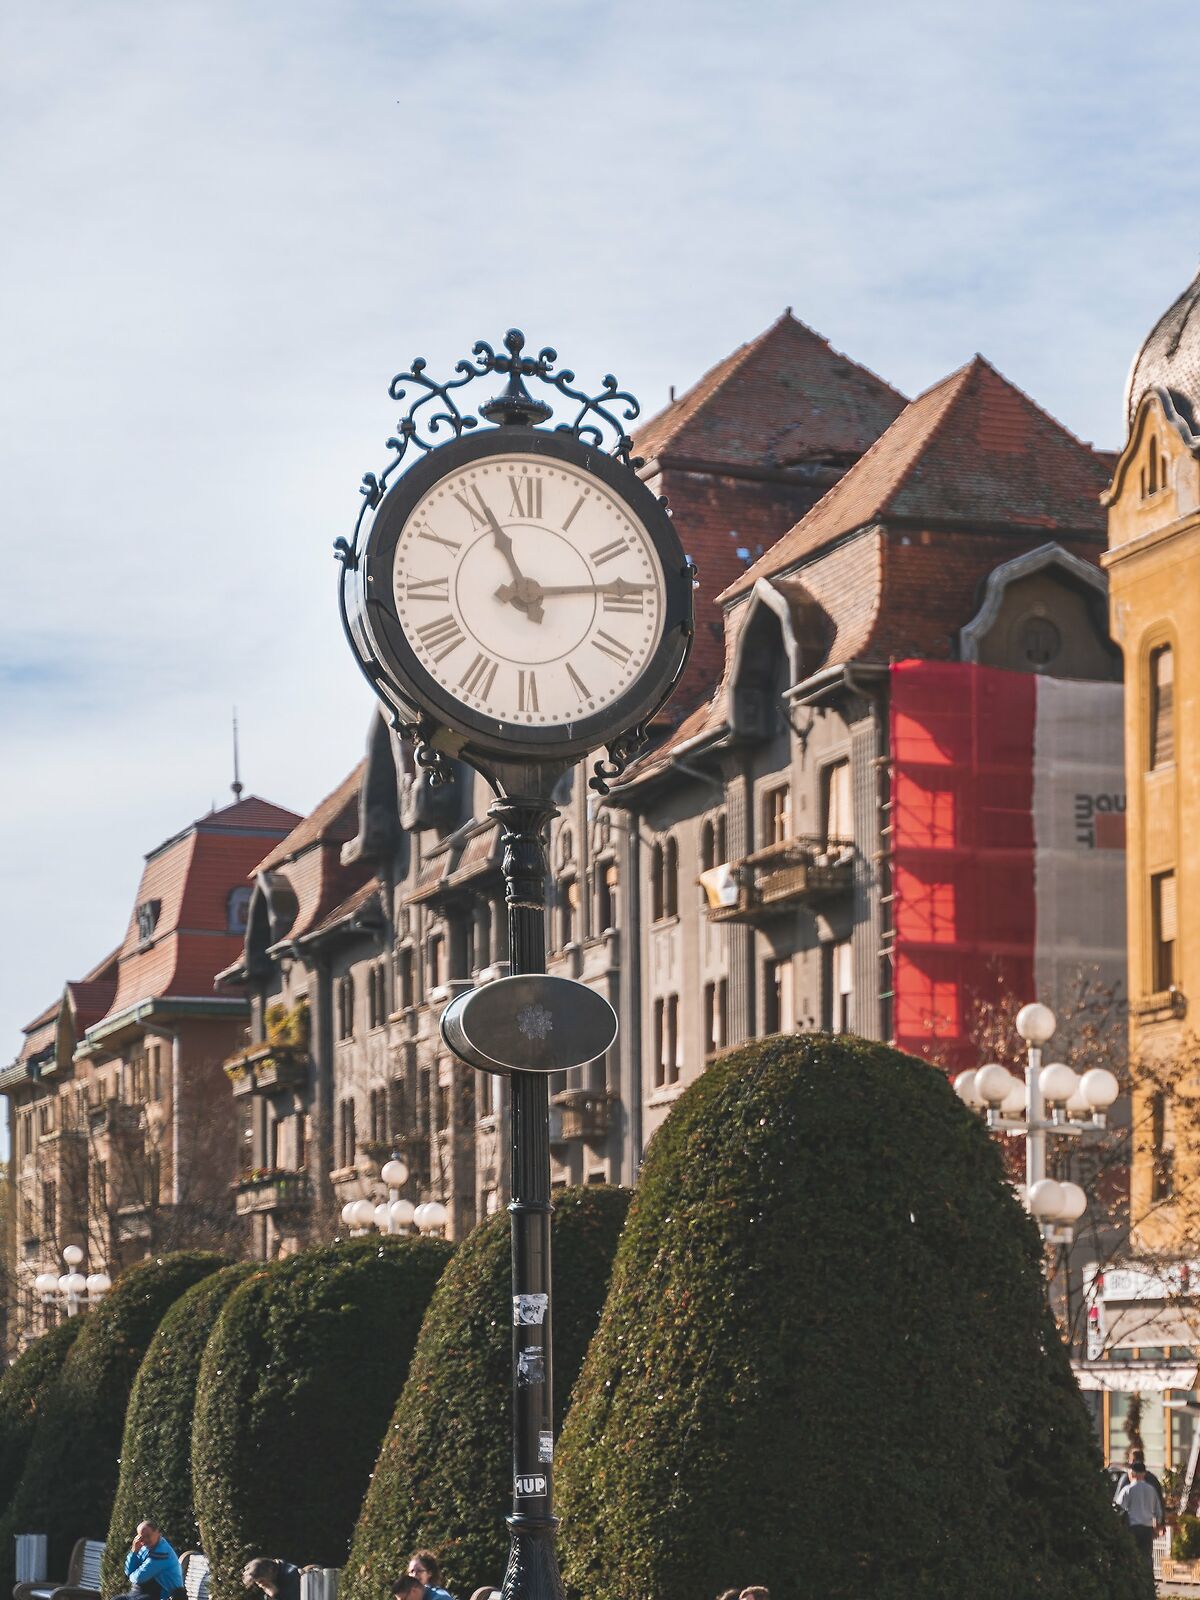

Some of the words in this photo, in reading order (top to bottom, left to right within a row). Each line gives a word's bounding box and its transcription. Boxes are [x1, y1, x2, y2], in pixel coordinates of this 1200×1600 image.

[507, 475, 544, 519] XII
[561, 495, 587, 532] I
[417, 522, 462, 558] X
[588, 537, 630, 568] II
